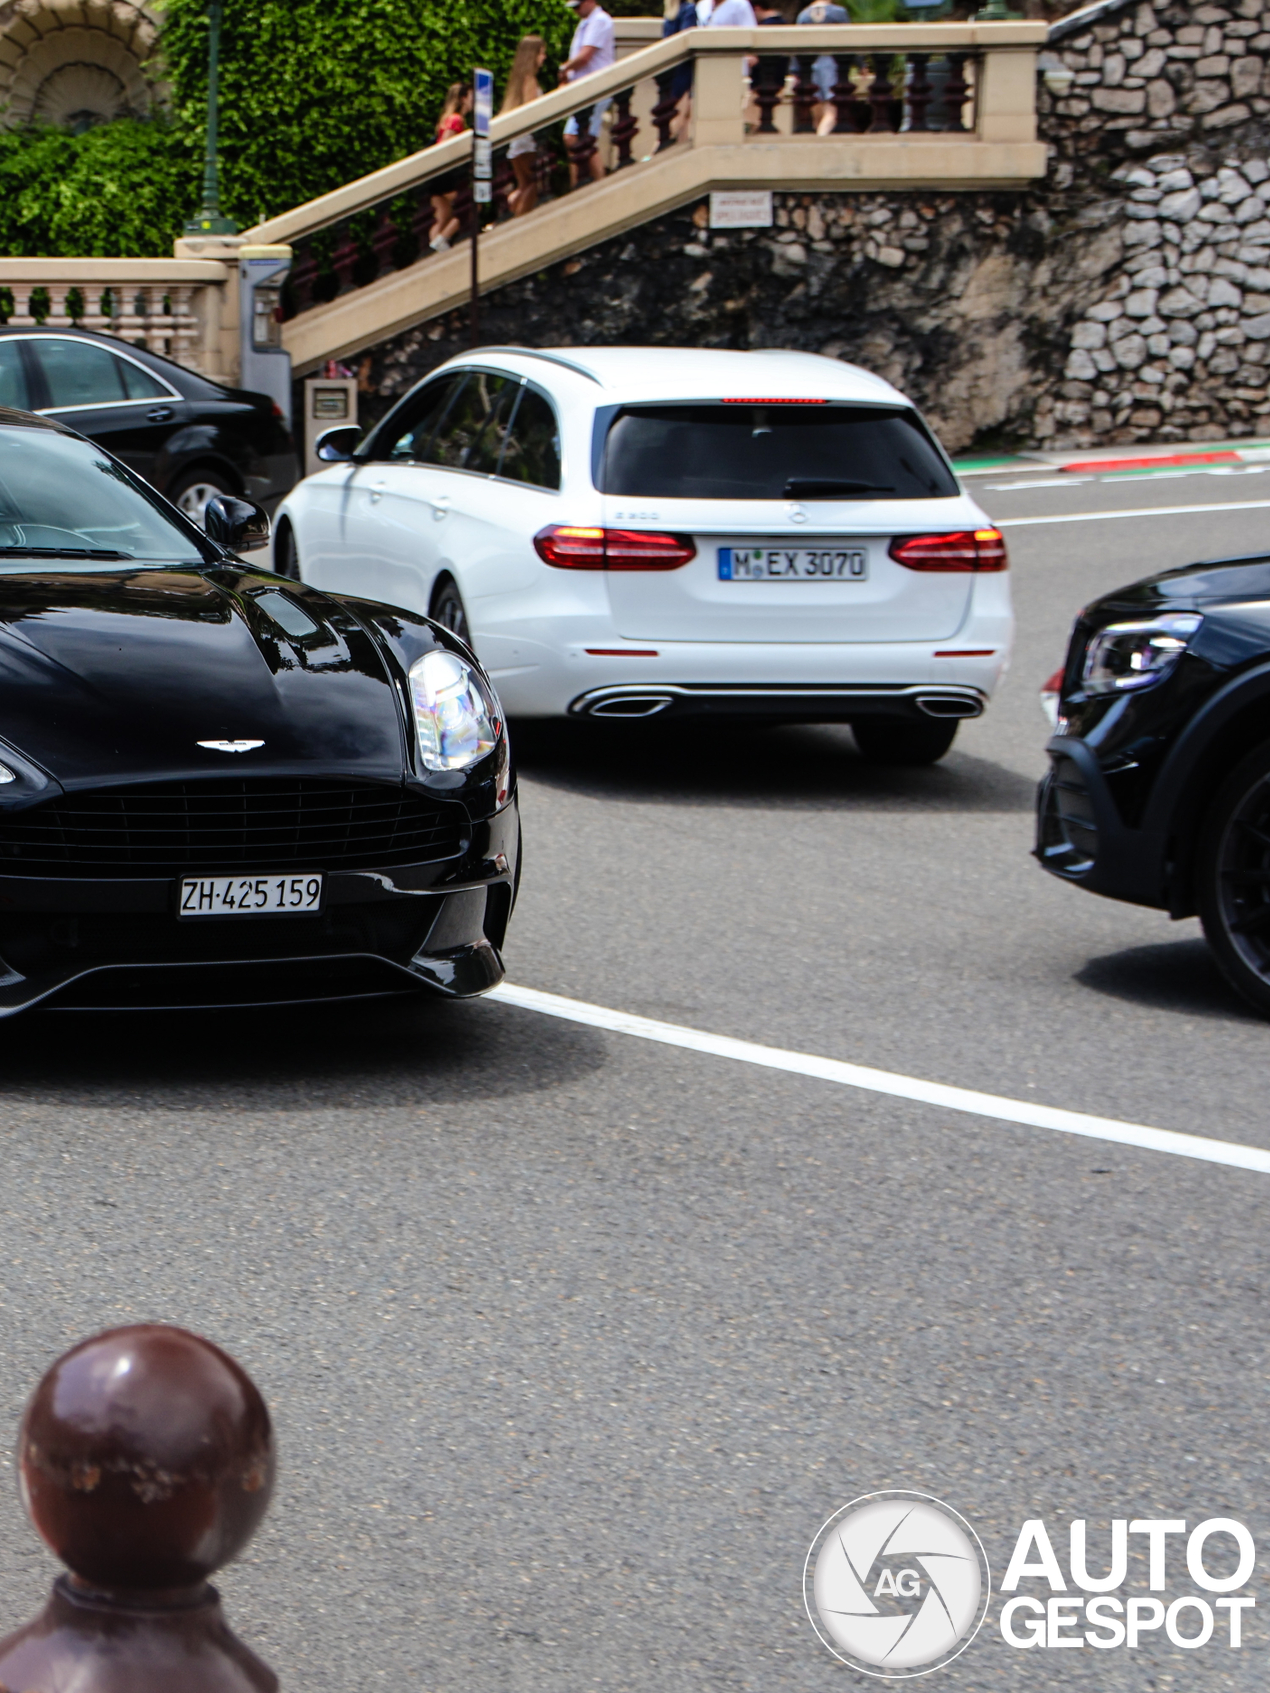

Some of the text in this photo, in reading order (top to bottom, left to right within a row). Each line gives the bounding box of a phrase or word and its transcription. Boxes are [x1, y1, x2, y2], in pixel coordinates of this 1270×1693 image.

[735, 552, 863, 576] M EX 3070
[276, 878, 320, 908] 159
